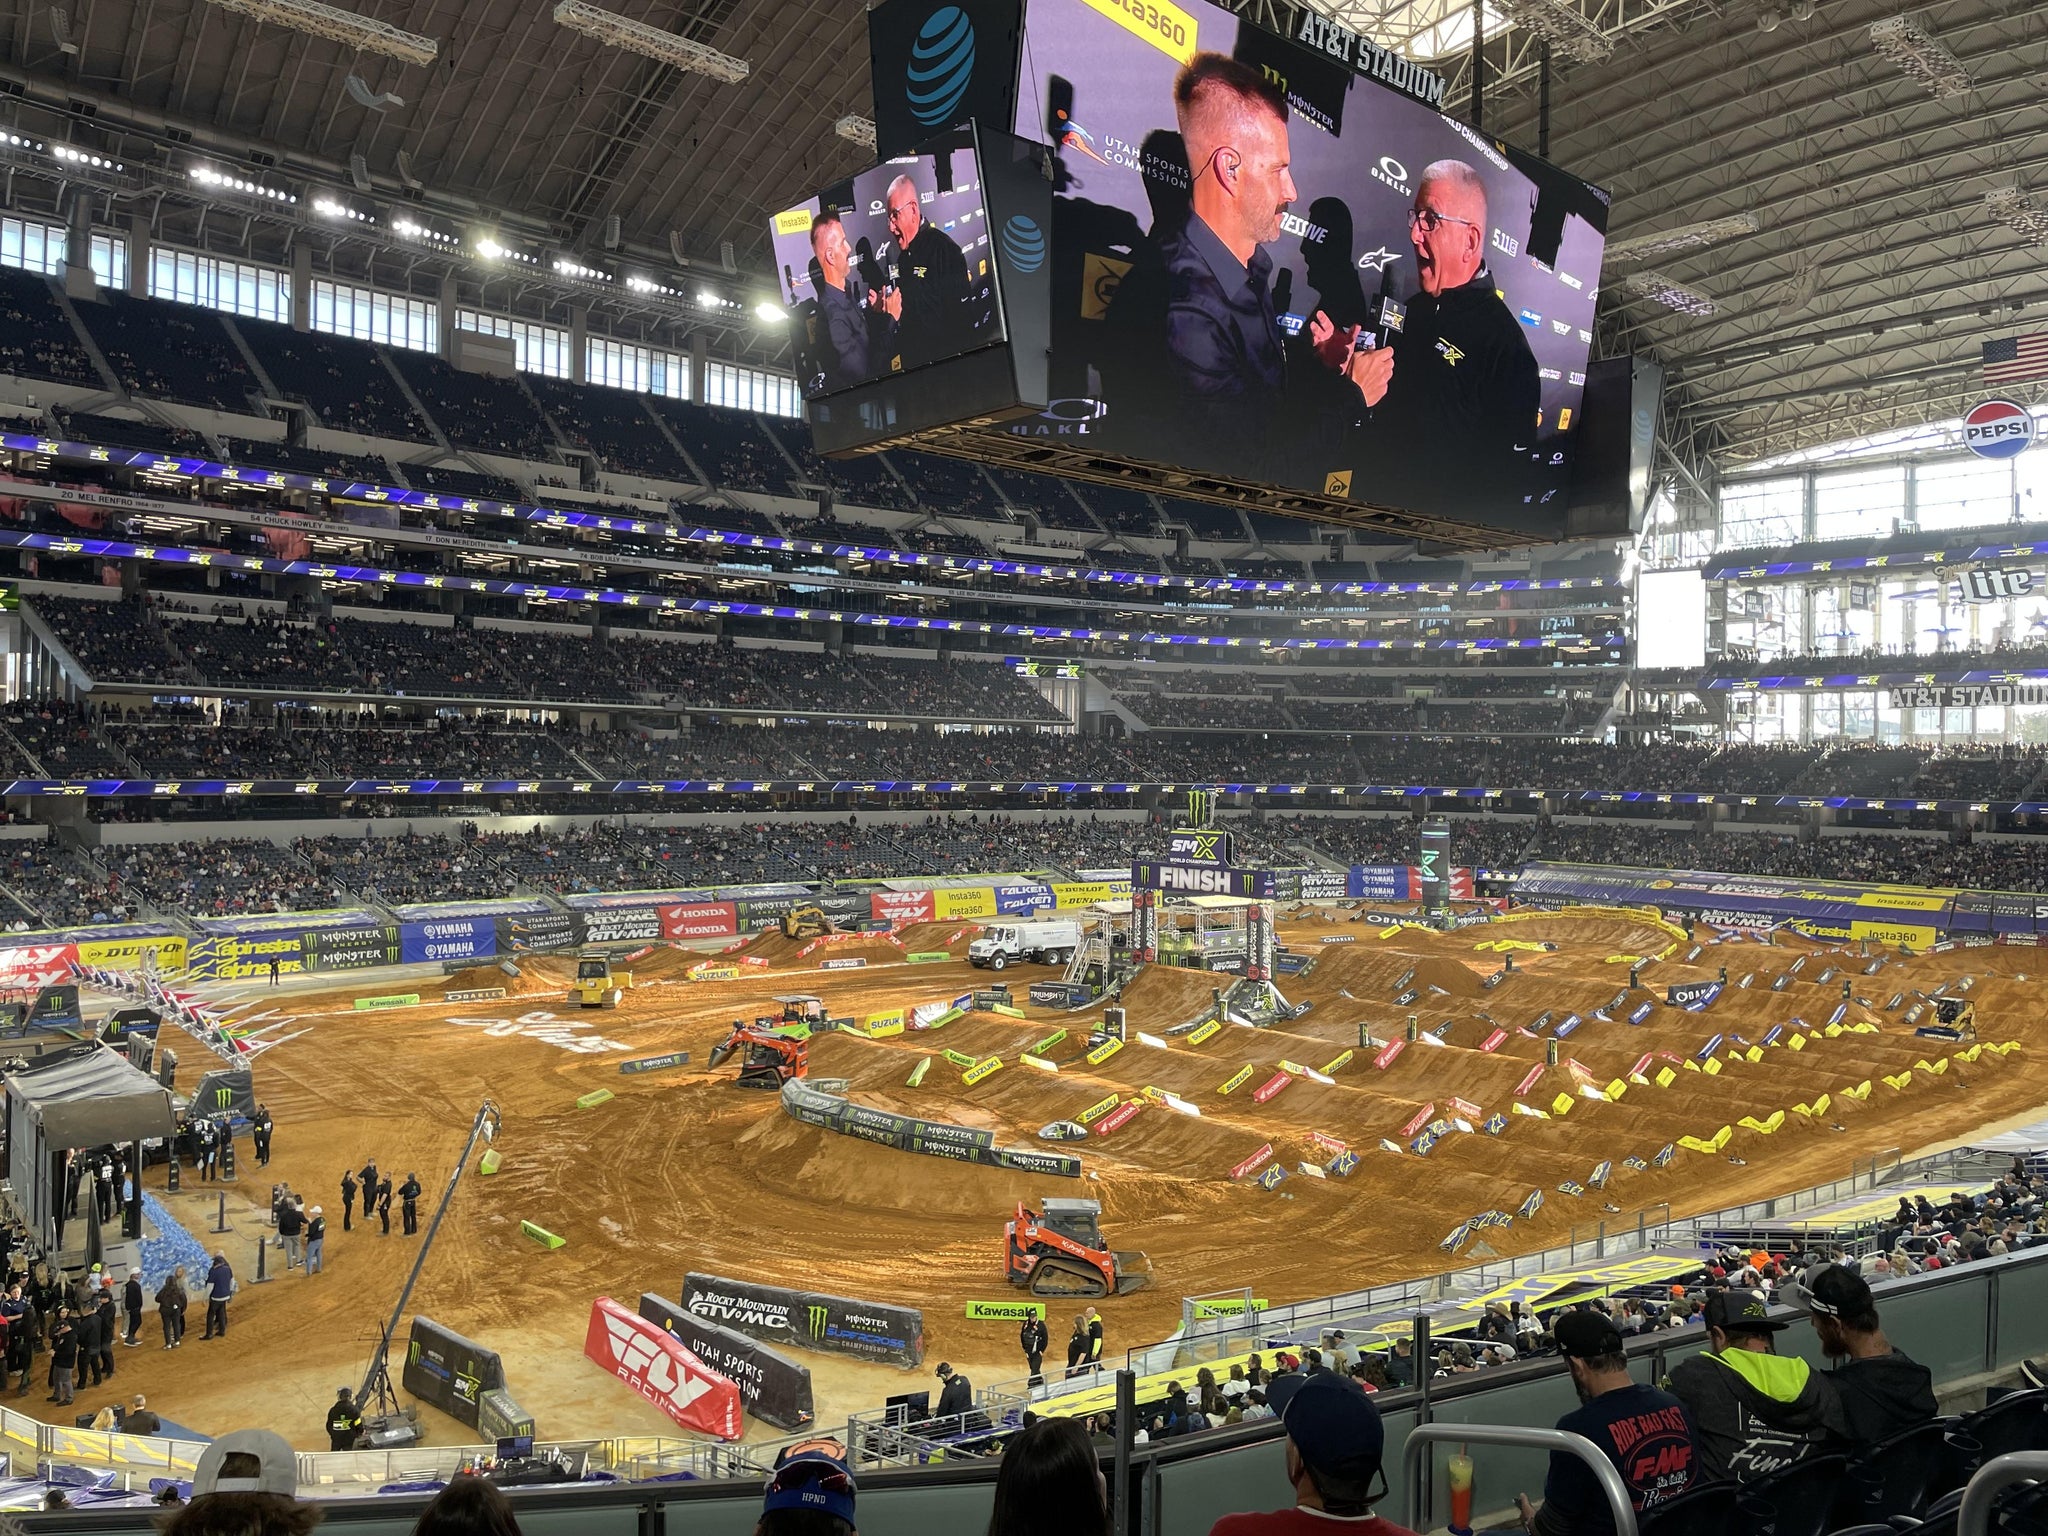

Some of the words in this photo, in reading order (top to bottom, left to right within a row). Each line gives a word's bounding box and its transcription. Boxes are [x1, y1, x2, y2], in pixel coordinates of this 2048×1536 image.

[1299, 11, 1355, 62] AT&T
[1357, 38, 1446, 107] STADIUM
[1287, 91, 1334, 129] MONSTER
[1293, 108, 1328, 132] ENERGY
[1461, 126, 1509, 171] CHAMPIONSHIP
[1105, 135, 1141, 158] UTAH
[1146, 153, 1189, 179] SPORTS
[1104, 150, 1187, 189] COMMISSION
[1371, 167, 1412, 197] OAKLEY
[781, 214, 809, 227] Insta360
[1967, 421, 2029, 440] PEPSI
[61, 490, 74, 499] 20
[78, 493, 97, 501] MEL
[99, 495, 133, 506] RENFRO
[264, 516, 290, 526] CHUCK
[291, 520, 324, 530] HOWLEY
[452, 538, 487, 549] MEREDITH
[1957, 569, 2033, 604] Lite
[1889, 687, 1946, 707] AT&T
[1170, 836, 1219, 859] SMX
[1159, 866, 1231, 893] FINISH
[1369, 875, 1394, 883] YAMAHA
[877, 891, 928, 903] FLY
[948, 891, 981, 901] Insta360
[1001, 886, 1047, 896] FALKEN
[1370, 887, 1394, 895] YAMAHA
[750, 901, 791, 911] MONSTER
[820, 898, 851, 907] TRIUMPH
[1003, 895, 1051, 909] FALKEN
[615, 908, 655, 917] MOUNTAIN
[682, 908, 728, 918] HONDA
[879, 906, 929, 919] FLY
[949, 905, 983, 915] Insta360
[1712, 909, 1734, 918] ROCKY
[1735, 911, 1773, 920] MOUNTAIN
[527, 921, 570, 930] COMMISSION
[622, 922, 659, 930] MOUNTAIN
[1457, 915, 1489, 924] MONSTER
[322, 930, 381, 943] MONSTER
[428, 932, 472, 940] RACING
[435, 923, 474, 936] YAMAHA
[528, 934, 548, 942] UTAH
[549, 931, 573, 940] SPORTS
[684, 925, 728, 935] HONDA
[1869, 929, 1917, 942] Insta360
[221, 938, 301, 960] alpinestars
[332, 940, 374, 948] ENERGY
[436, 942, 475, 955] YAMAHA
[529, 937, 573, 948] COMMISSION
[803, 941, 818, 954] FLY
[322, 949, 382, 963] MONSTER
[332, 961, 374, 969] ENERGY
[696, 970, 733, 980] SUZUKI
[463, 991, 506, 1000] OAKLEY
[1030, 991, 1058, 1001] TRIUMPH
[369, 998, 407, 1008] Kawasaki
[1192, 1022, 1217, 1041] SUZUKI
[1040, 1033, 1065, 1052] Kawasaki
[1489, 1031, 1505, 1047] HONDA
[1091, 1041, 1120, 1060] SUZUKI
[1384, 1041, 1401, 1061] HONDA
[643, 1057, 673, 1067] MONSTER
[949, 1051, 975, 1066] Kawasaki
[1328, 1054, 1351, 1074] SUZUKI
[967, 1059, 999, 1081] SUZUKI
[1226, 1068, 1252, 1092] SUZUKI
[1266, 1076, 1288, 1095] HONDA
[207, 1108, 241, 1118] MONSTER
[1085, 1098, 1117, 1120] SUZUKI
[801, 1110, 825, 1123] MONSTER
[856, 1110, 892, 1127] MONSTER
[1108, 1106, 1136, 1127] HONDA
[852, 1125, 884, 1140] MONSTER
[927, 1126, 972, 1141] MONSTER
[932, 1134, 964, 1143] ENERGY
[924, 1141, 967, 1156] MONSTER
[929, 1150, 960, 1159] ENERGY
[1013, 1154, 1058, 1168] MONSTER
[1245, 1149, 1272, 1174] HONDA
[1061, 1239, 1086, 1256] Kubota
[705, 1291, 735, 1307] ROCKY
[735, 1297, 790, 1315] MOUNTAIN
[845, 1313, 888, 1329] MONSTER
[851, 1324, 882, 1333] ENERGY
[826, 1327, 906, 1348] SUPERCROSS
[841, 1340, 888, 1354] CHAMPIONSHIP
[602, 1309, 714, 1410] FLY
[692, 1338, 720, 1362] UTAH
[724, 1353, 764, 1383] SPORTS
[455, 1375, 479, 1400] SMX
[1607, 1415, 1641, 1455] RIDE
[1641, 1411, 1663, 1435] BAD
[1662, 1406, 1690, 1435] FAST
[1767, 1429, 1803, 1438] CHAMPIONSHIP
[1633, 1444, 1692, 1481] FMF
[801, 1492, 826, 1505] HPND
